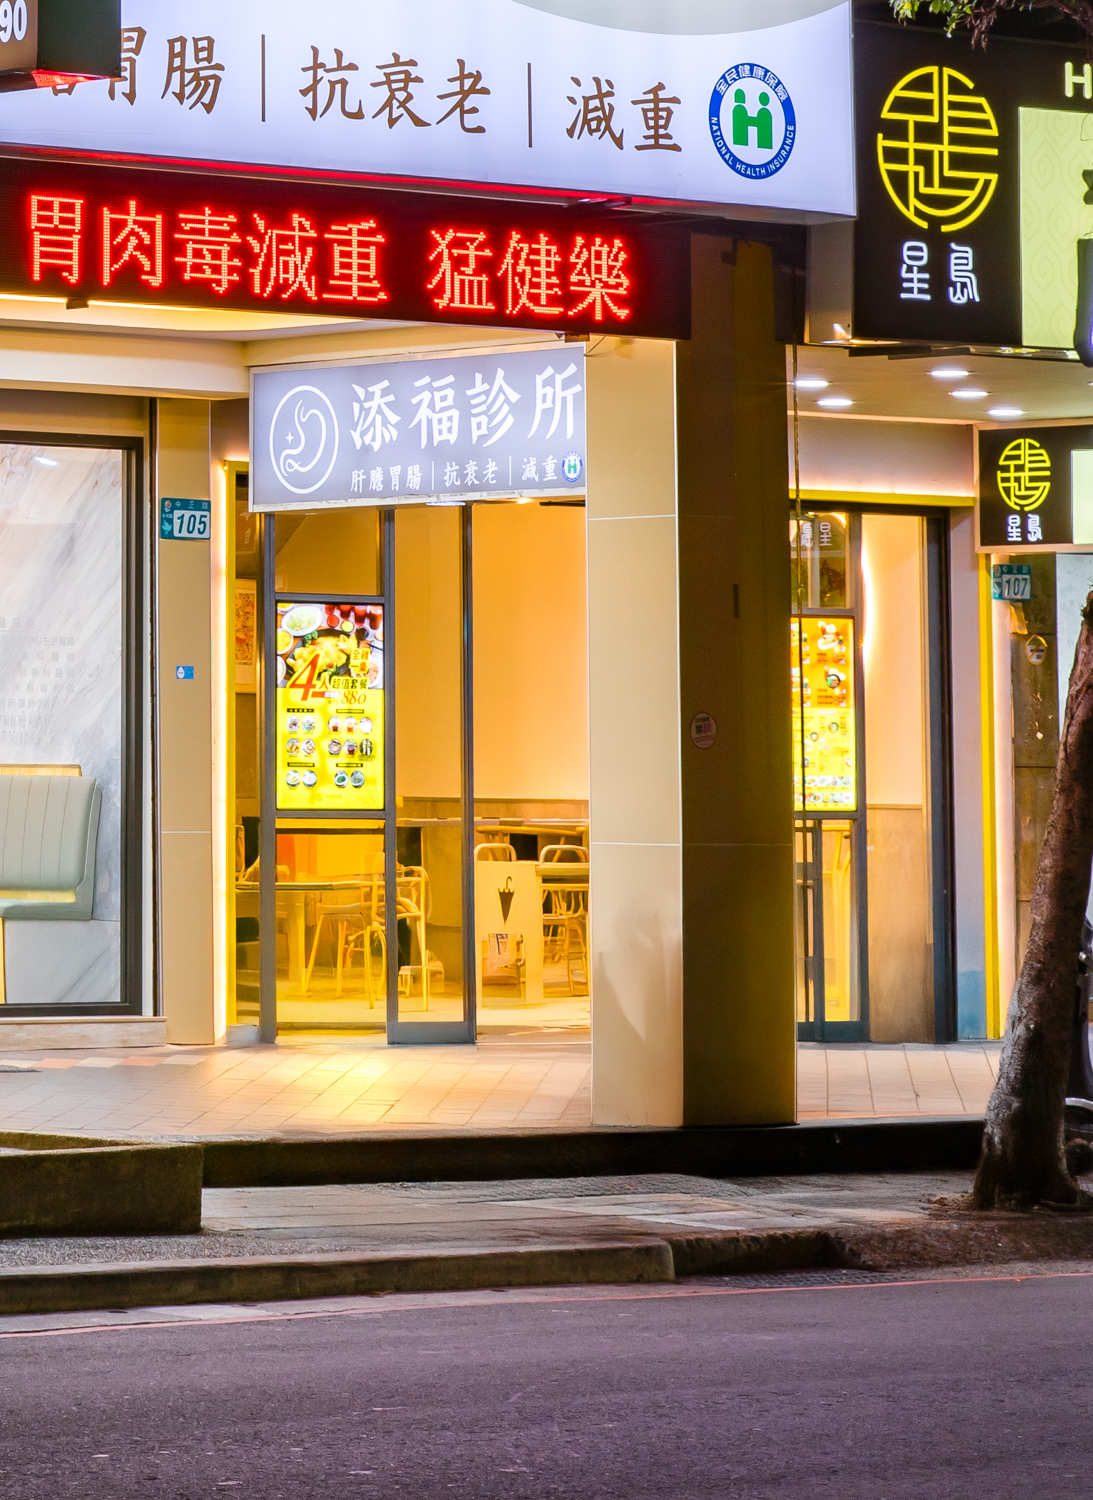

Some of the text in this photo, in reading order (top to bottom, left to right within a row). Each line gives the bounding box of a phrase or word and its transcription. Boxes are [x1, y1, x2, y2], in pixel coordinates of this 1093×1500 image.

[51, 26, 682, 153] 胃腸 抗衰老 減重
[710, 116, 795, 177] NATIONAL HEALTH INSURANCE
[29, 193, 632, 323] 胃肉毒減重 猛健樂
[350, 362, 583, 452] 添福診所
[350, 464, 423, 493] 肝膽胃腸
[443, 458, 499, 487] 抗衰老
[521, 454, 559, 482] 減重
[176, 513, 208, 535] 105
[1005, 577, 1028, 597] 107
[341, 689, 367, 705] 880
